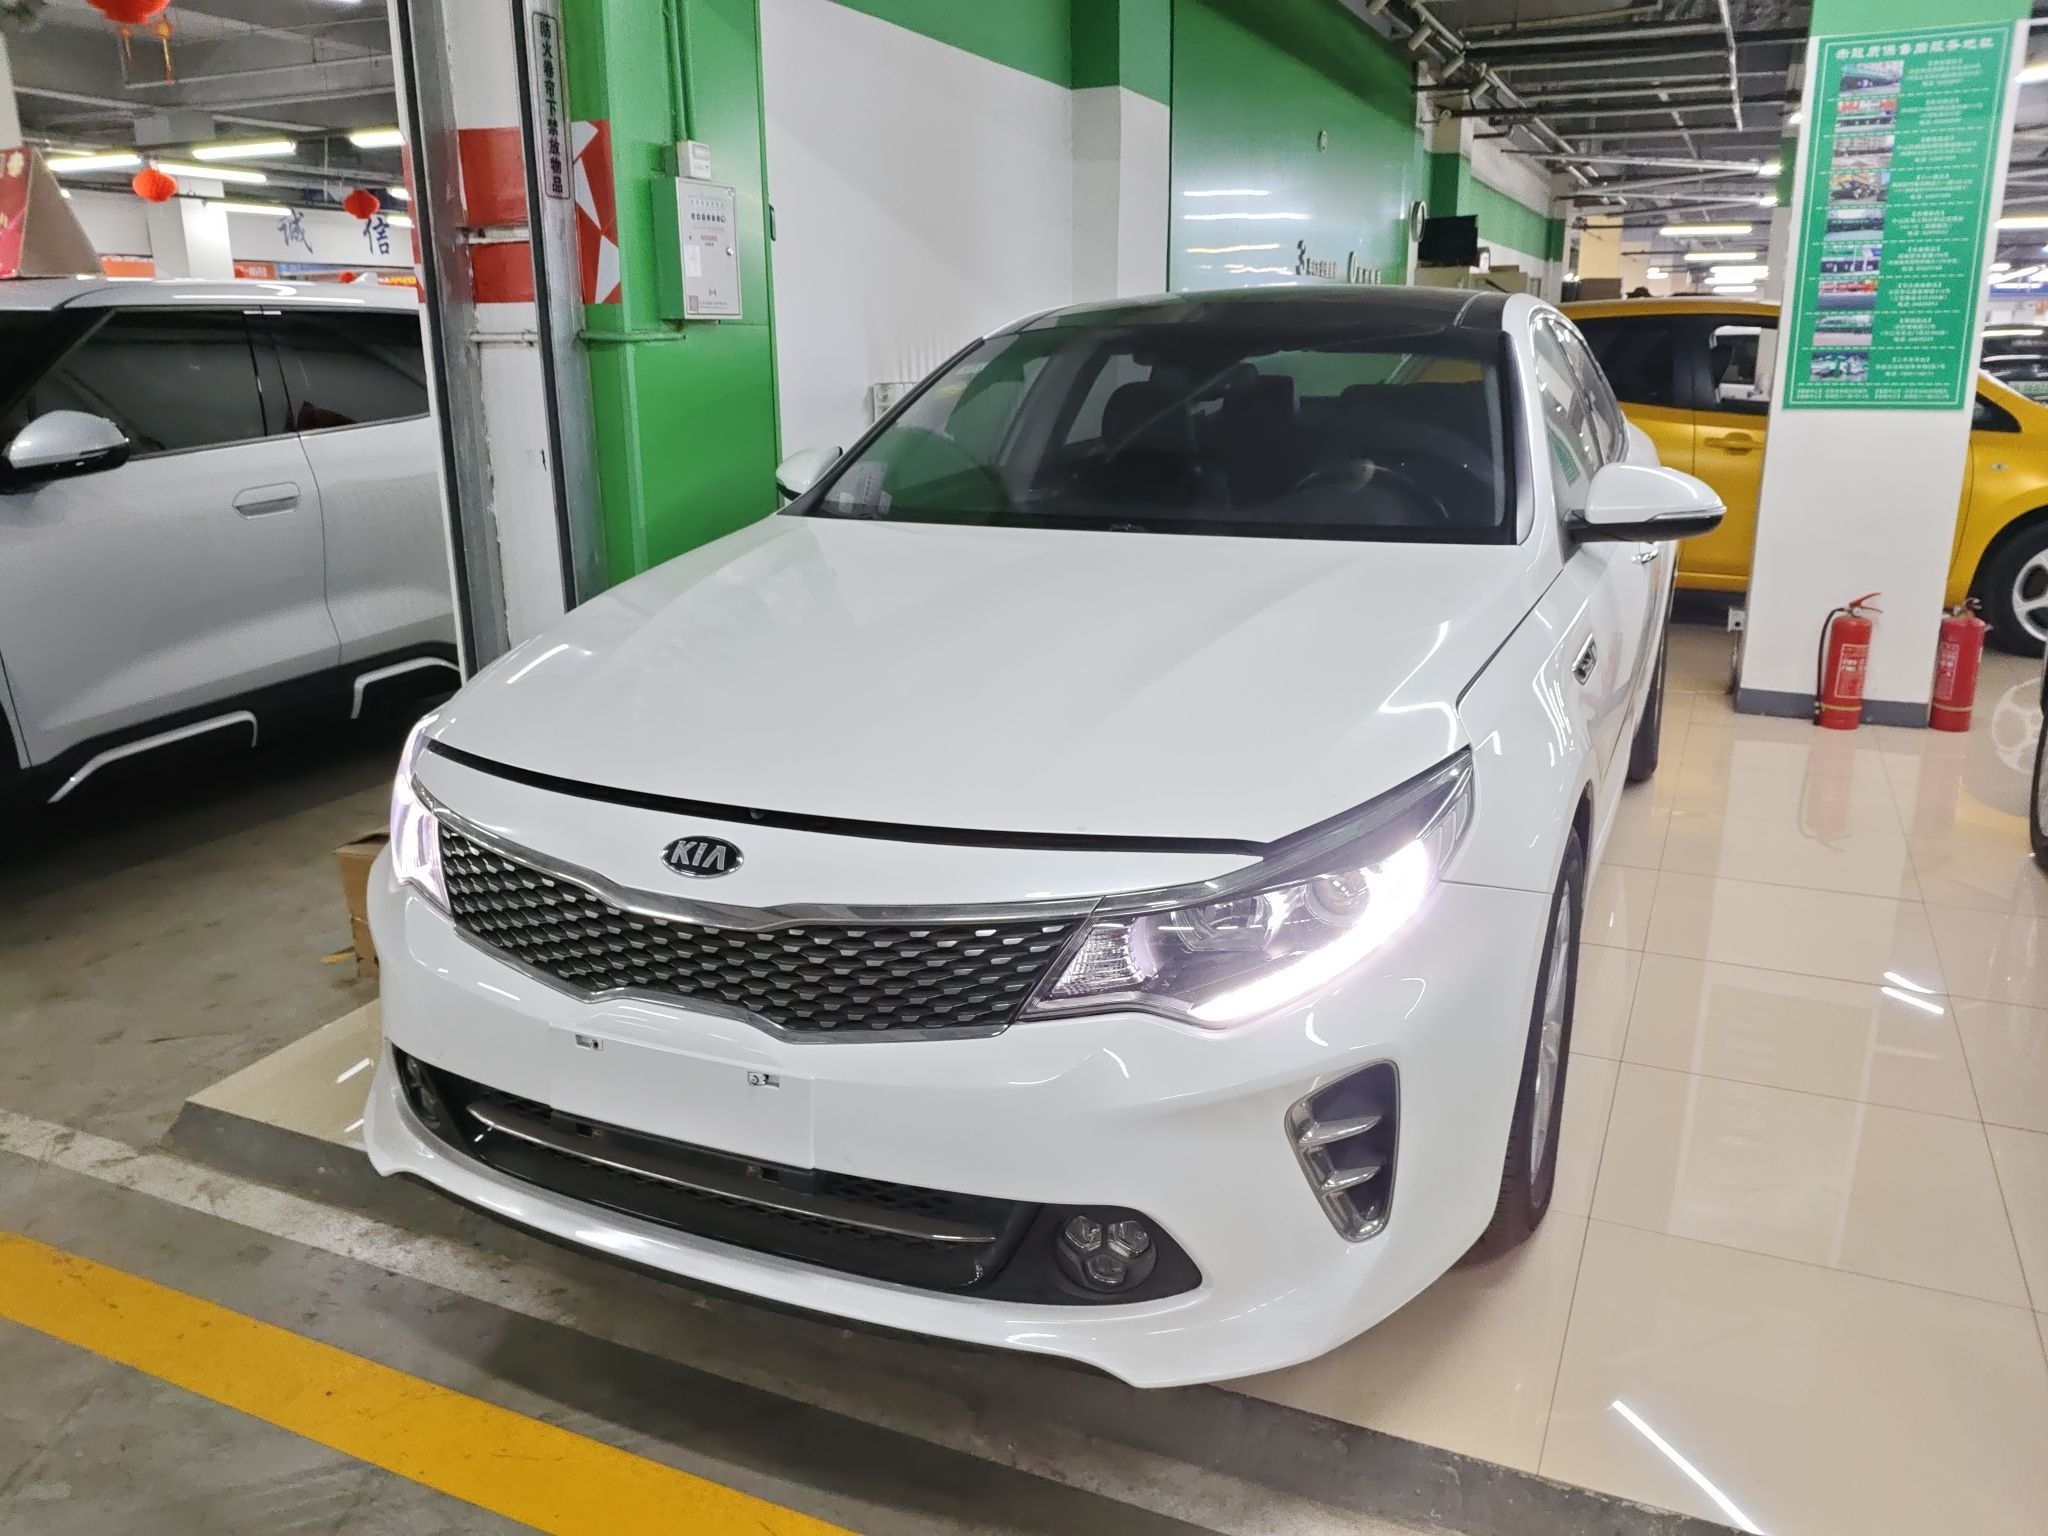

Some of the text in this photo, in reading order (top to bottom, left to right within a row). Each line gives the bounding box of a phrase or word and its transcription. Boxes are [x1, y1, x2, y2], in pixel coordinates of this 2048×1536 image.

[539, 20, 563, 194] 防火卷帘下禁放物品
[670, 840, 727, 871] KIA
